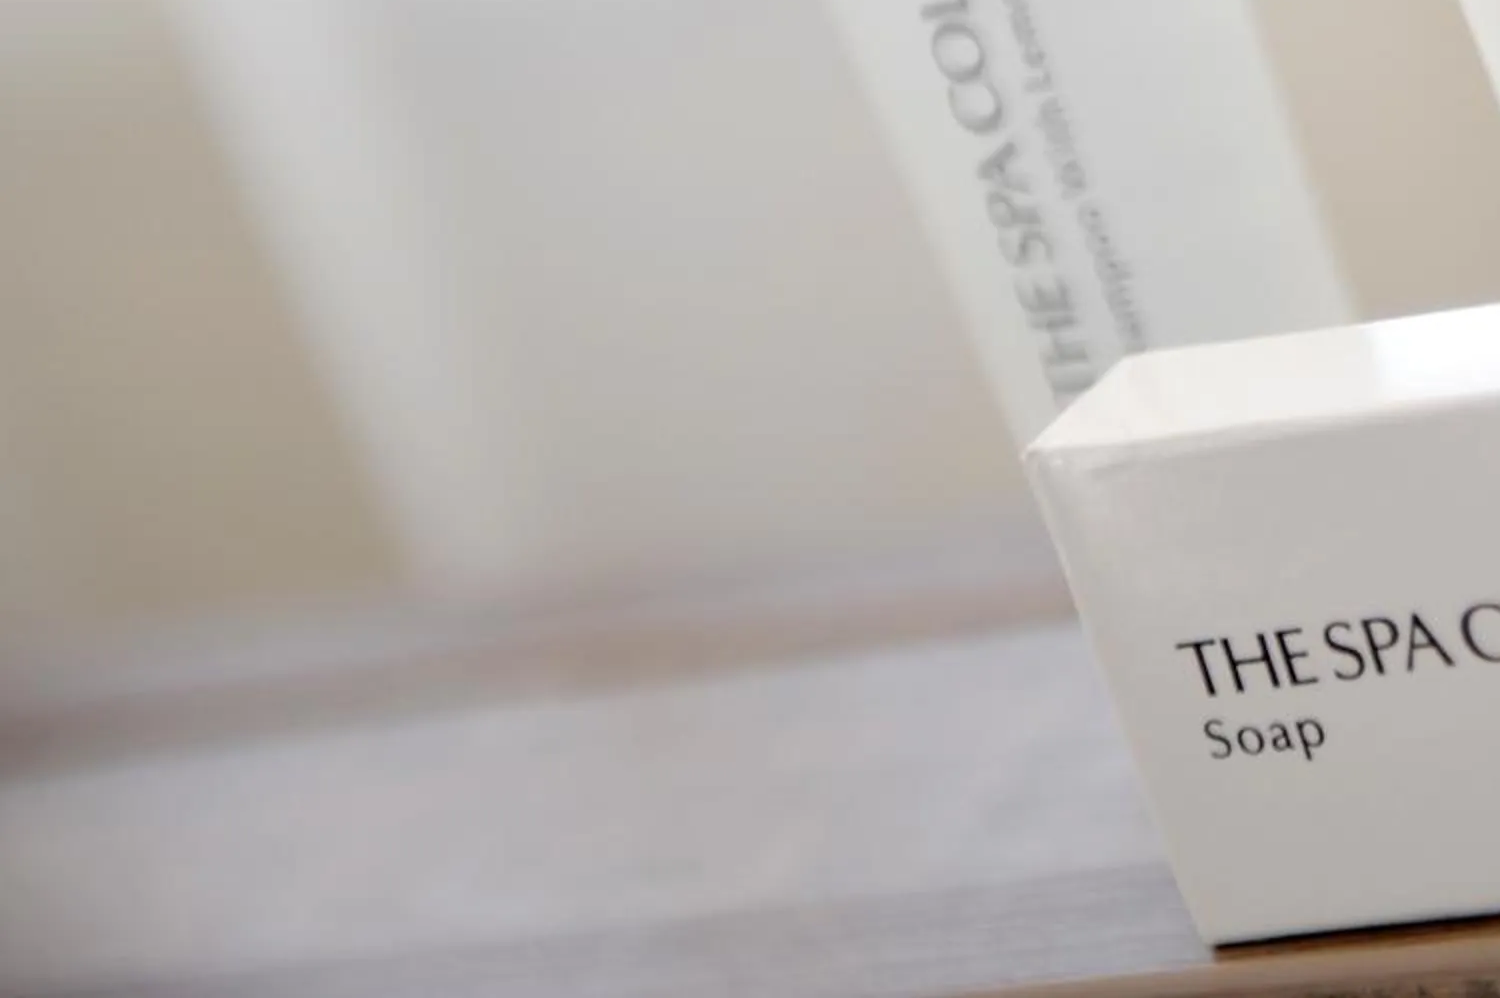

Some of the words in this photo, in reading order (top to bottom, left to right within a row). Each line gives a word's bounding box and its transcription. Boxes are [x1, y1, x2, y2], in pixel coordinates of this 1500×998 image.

[974, 140, 1056, 269] SPA
[1011, 274, 1097, 407] THE
[1175, 628, 1319, 698] THE
[1327, 614, 1455, 682] SPA
[1203, 717, 1327, 761] Soap
